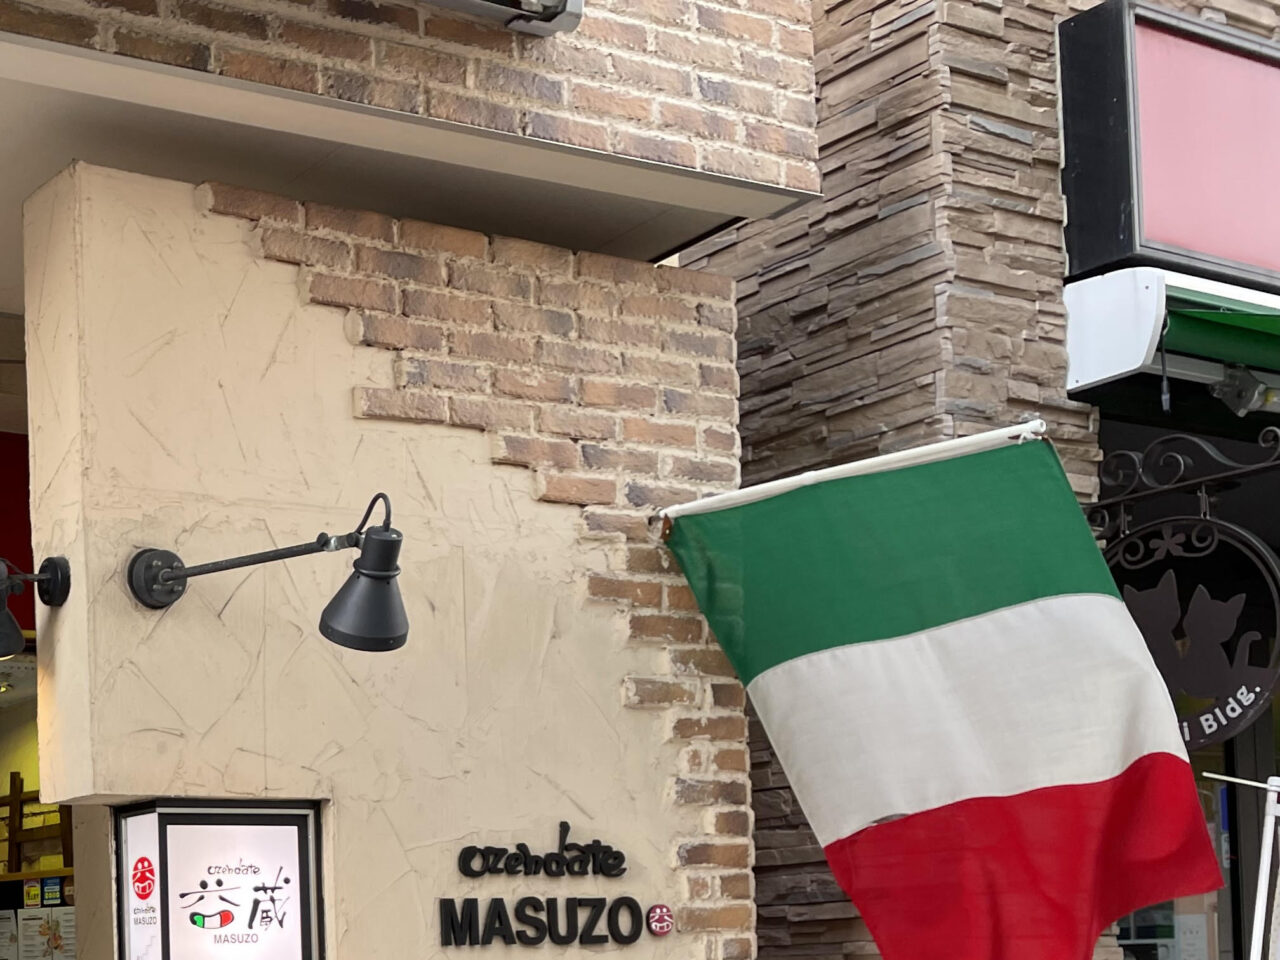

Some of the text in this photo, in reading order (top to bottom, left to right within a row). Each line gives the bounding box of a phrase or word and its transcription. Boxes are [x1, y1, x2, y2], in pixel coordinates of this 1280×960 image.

[1199, 685, 1261, 735] Bldg.
[213, 933, 259, 944] MASUZO
[439, 896, 644, 947] MASUZO
